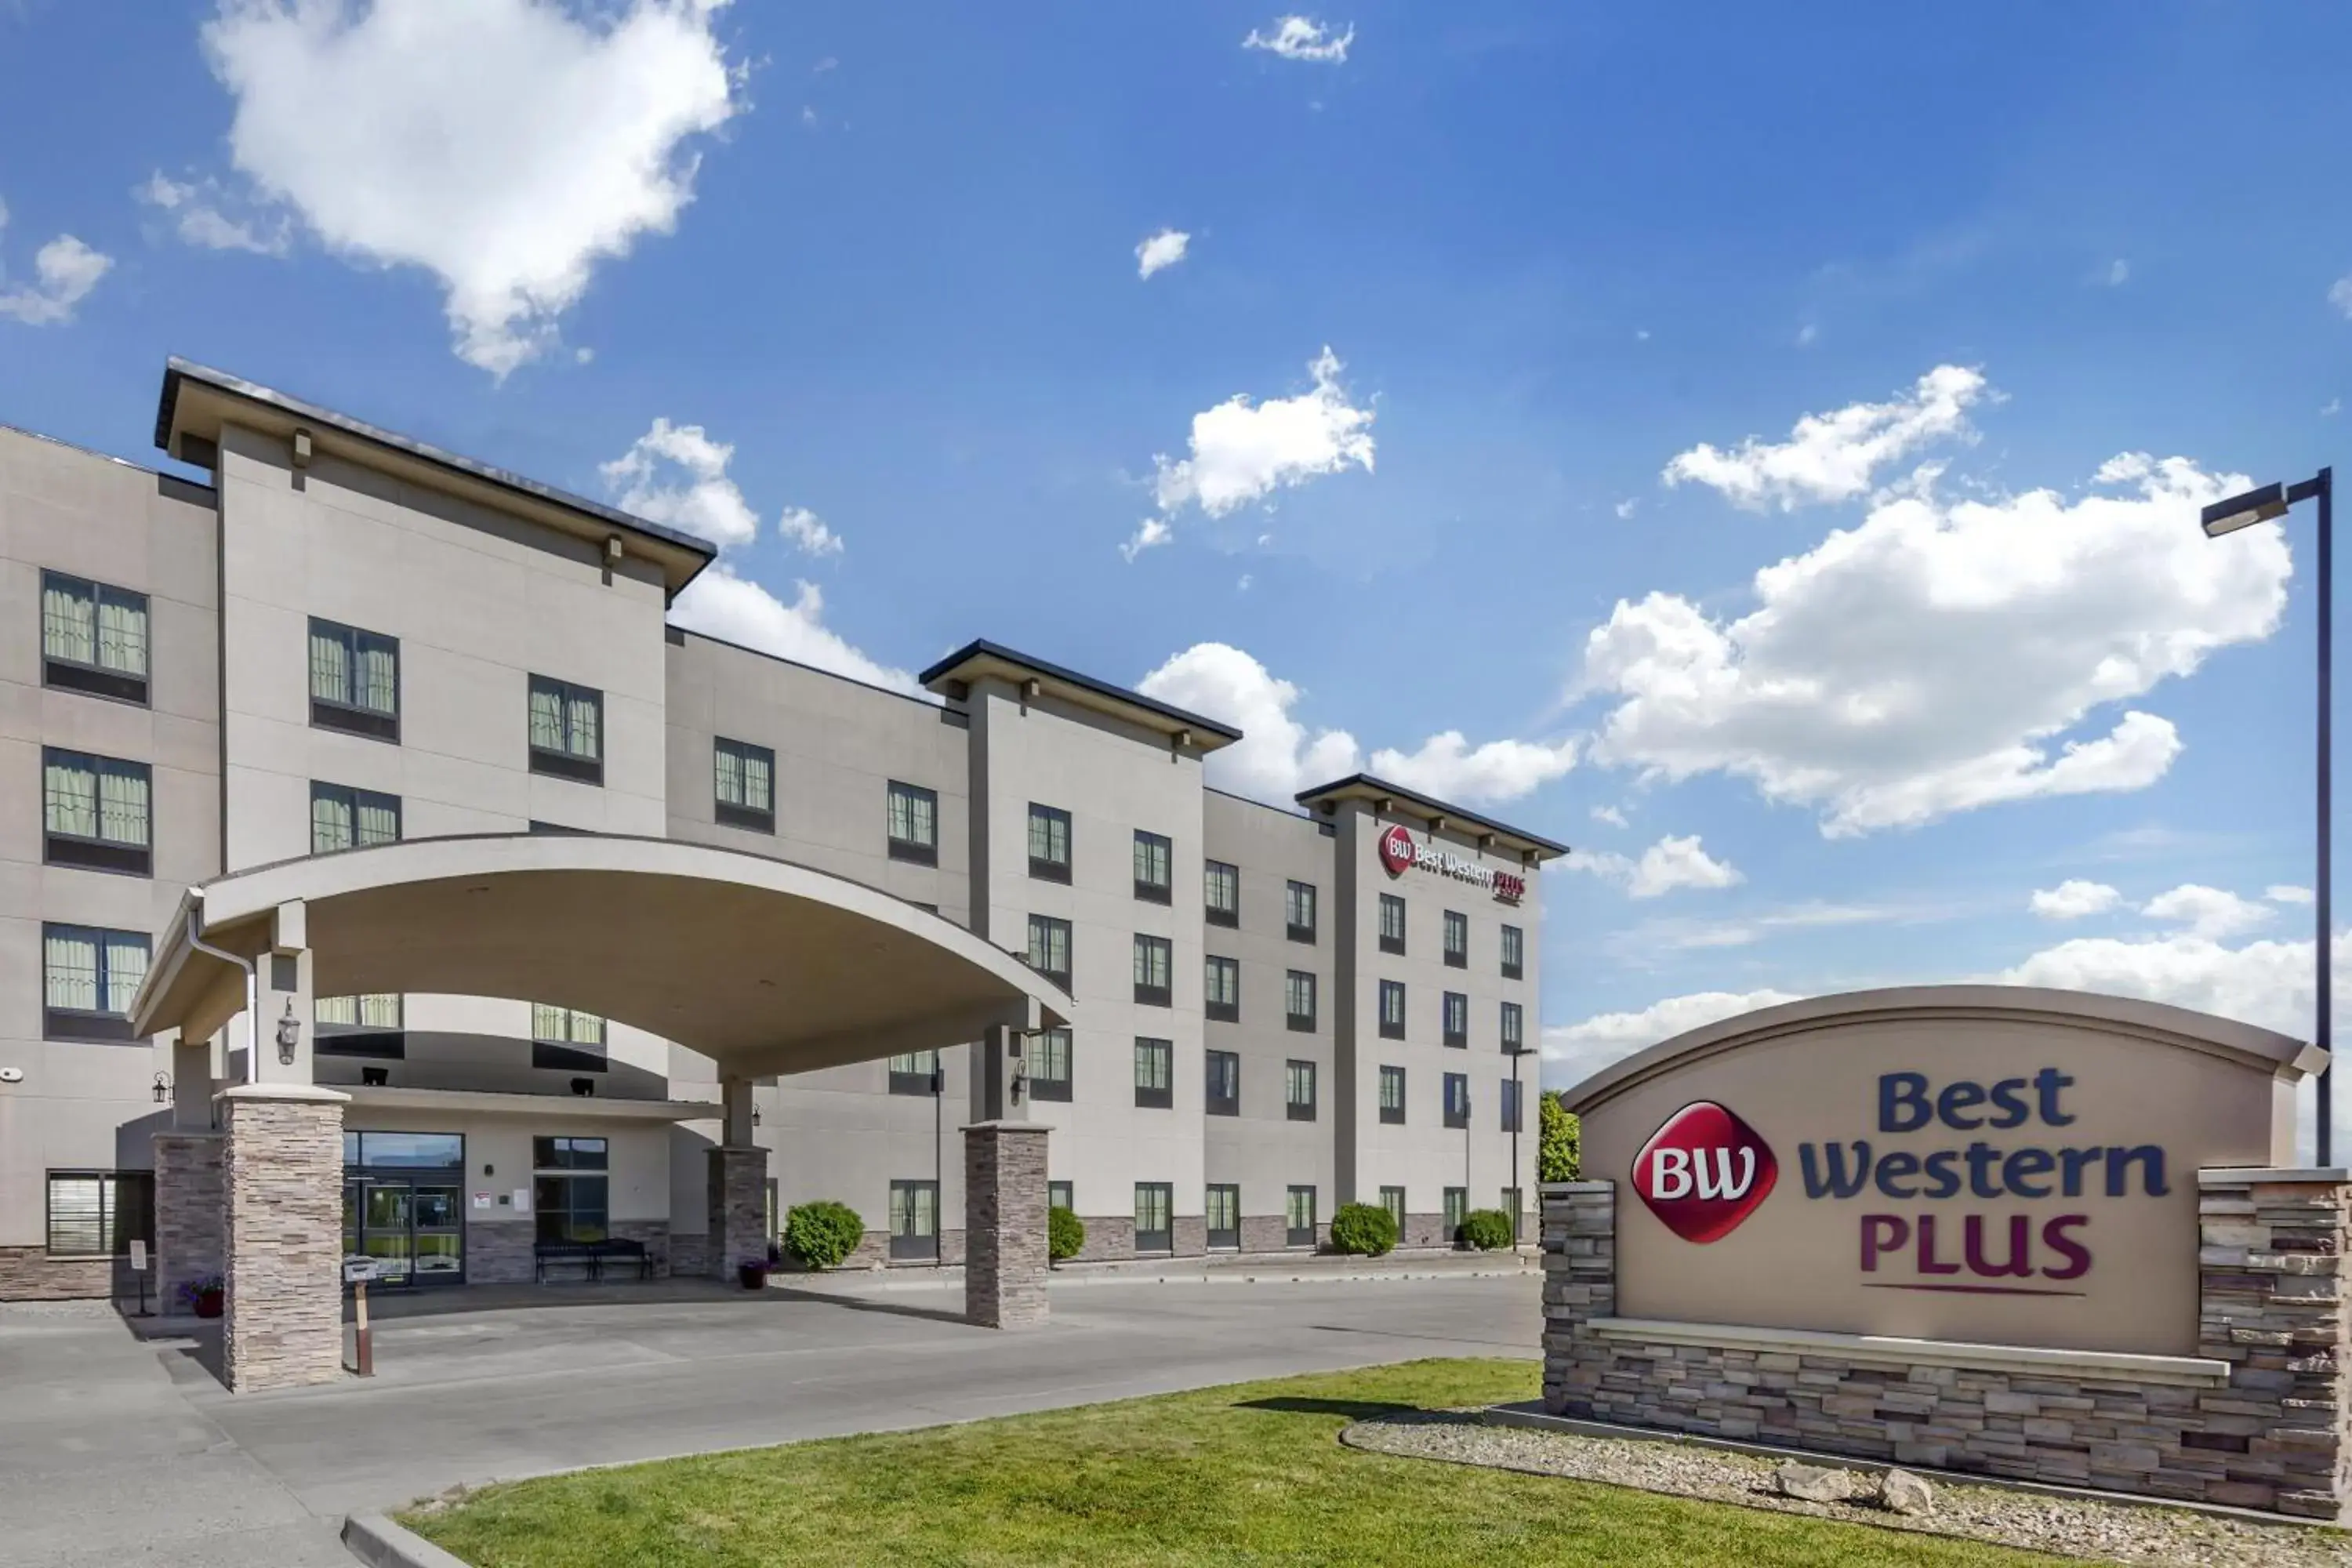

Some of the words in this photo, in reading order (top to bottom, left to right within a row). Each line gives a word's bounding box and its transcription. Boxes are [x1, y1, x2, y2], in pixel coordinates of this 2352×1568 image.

[1390, 837, 1410, 860] BW
[1415, 843, 1443, 869] Best
[1445, 851, 1494, 884] Western
[1494, 870, 1525, 895] PLUS
[1878, 1067, 2076, 1133] Best
[1651, 1146, 1755, 1200] BW
[1798, 1142, 2169, 1200] Western
[1860, 1214, 2092, 1279] PLUS
